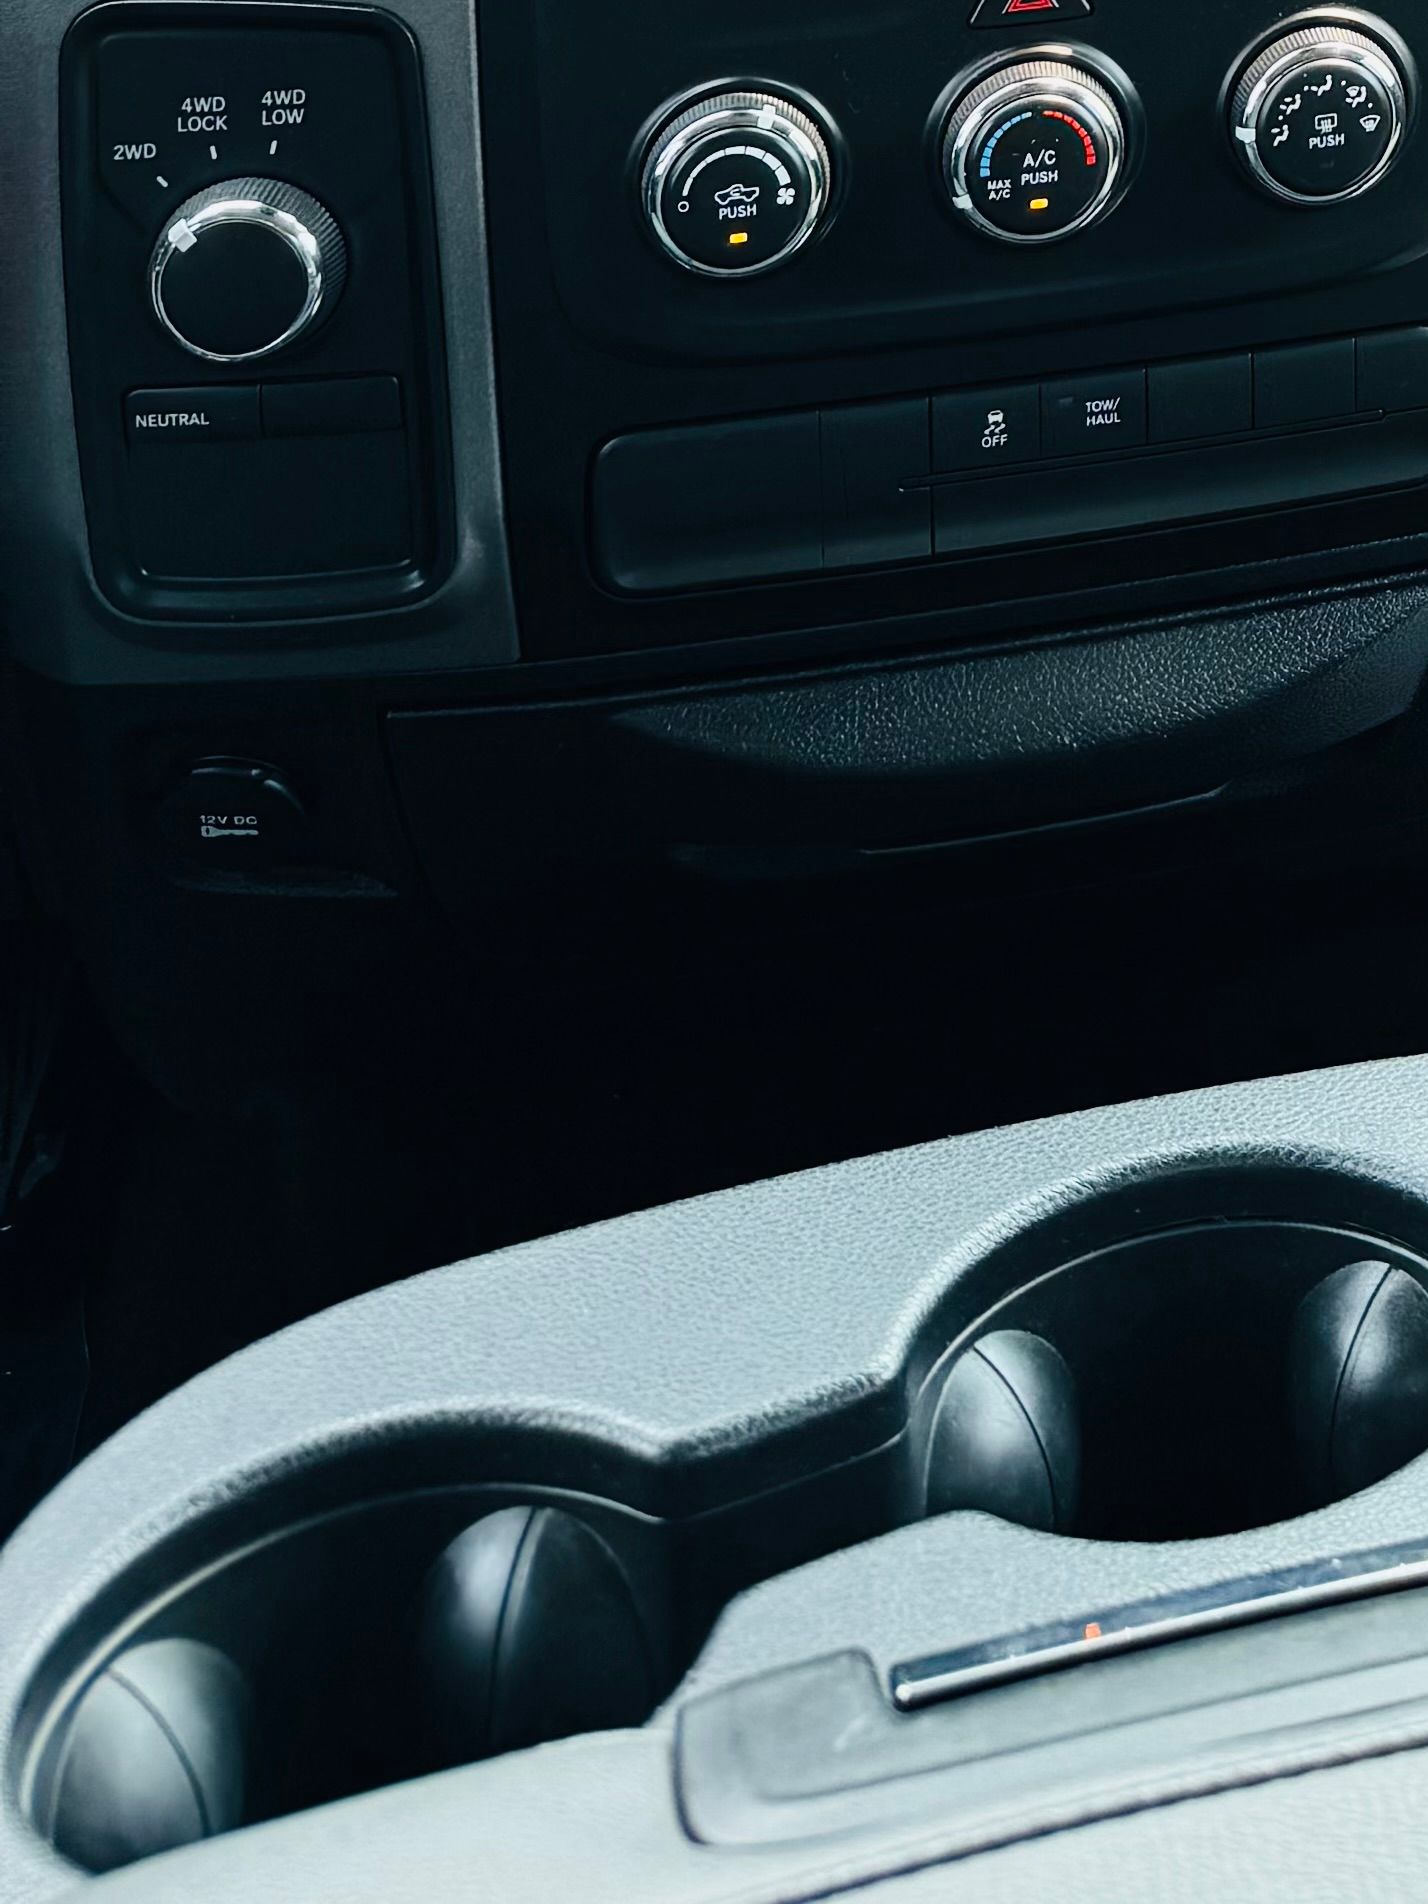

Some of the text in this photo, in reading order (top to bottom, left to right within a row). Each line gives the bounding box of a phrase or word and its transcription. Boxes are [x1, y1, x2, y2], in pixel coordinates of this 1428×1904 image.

[182, 97, 225, 112] 4WD
[262, 89, 305, 106] 4WD
[178, 116, 227, 132] LOCK
[262, 109, 304, 125] LOW
[1309, 134, 1344, 149] PUSH
[114, 144, 156, 160] 2WD
[1023, 149, 1055, 167] A/C
[988, 179, 1011, 189] MAX
[1021, 170, 1058, 185] PUSH
[989, 189, 1010, 200] A/C
[719, 204, 756, 220] PUSH
[1086, 397, 1120, 412] TOW/
[136, 413, 209, 427] NEUTRAL
[1087, 413, 1120, 426] HAUL
[982, 434, 1007, 447] OFF
[200, 814, 258, 825] 12V DC
